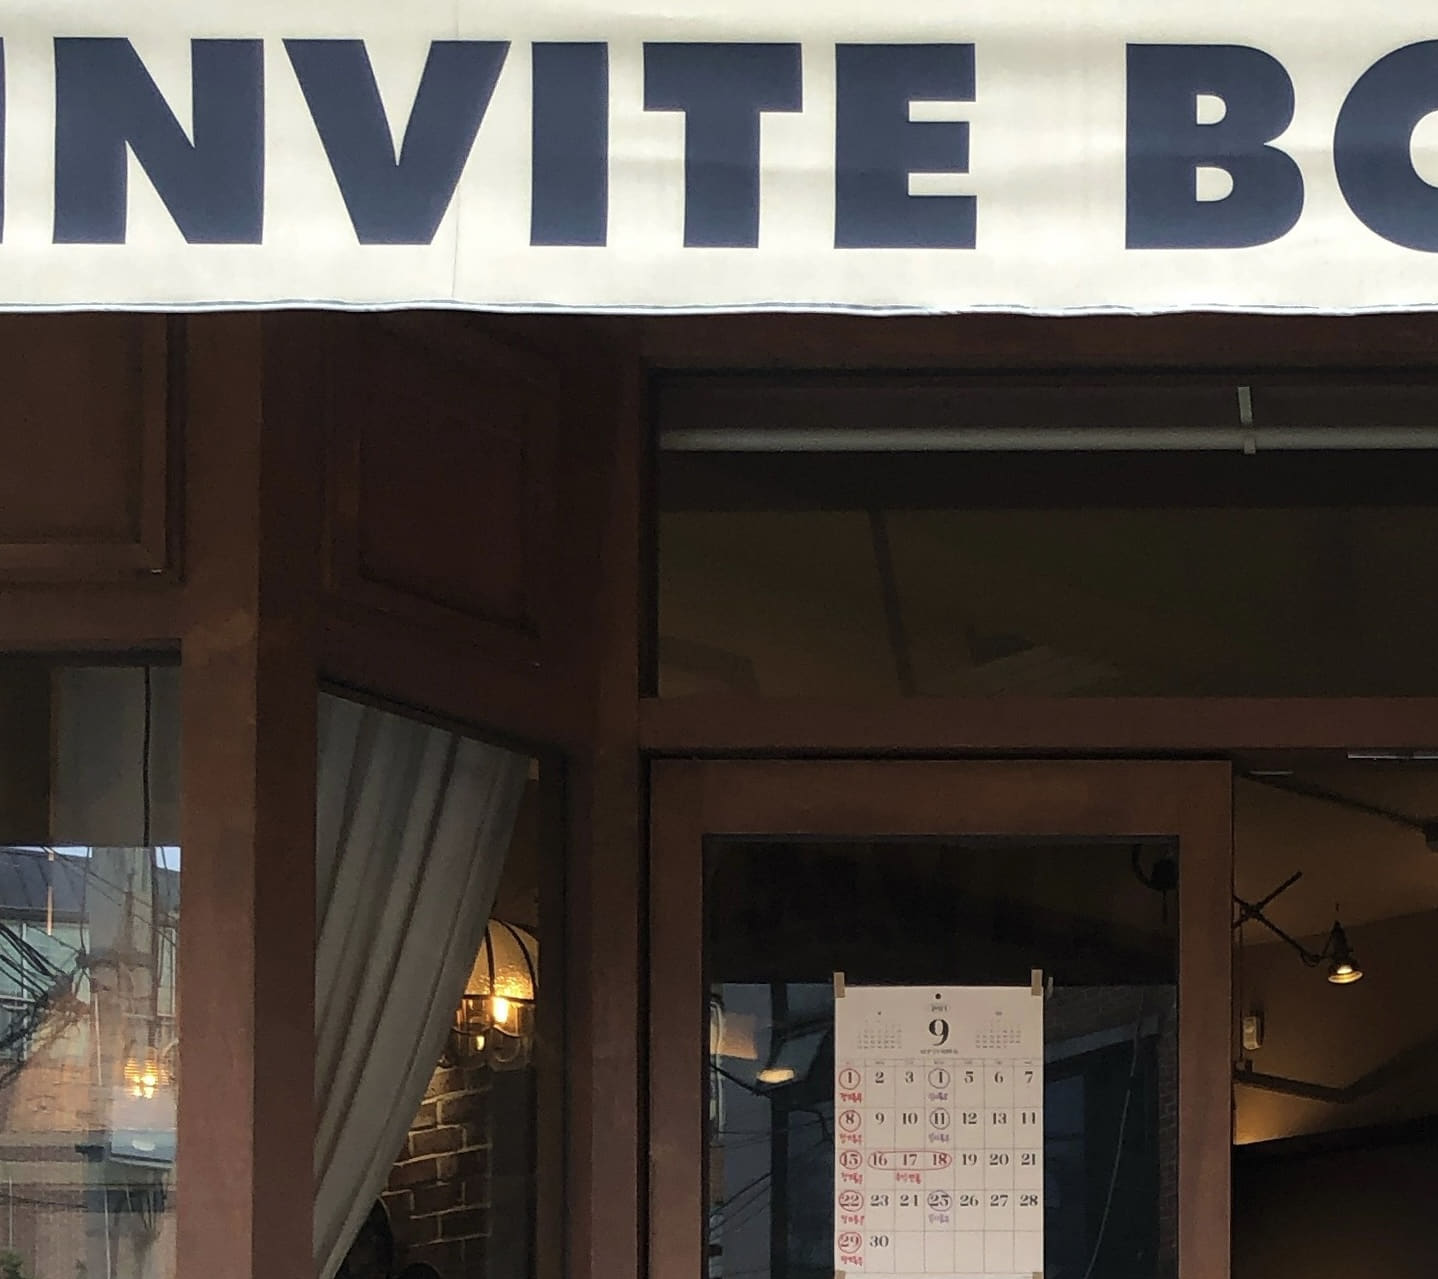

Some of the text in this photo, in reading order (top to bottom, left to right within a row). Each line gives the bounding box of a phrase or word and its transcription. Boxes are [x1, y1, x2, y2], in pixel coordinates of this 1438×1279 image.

[0, 36, 978, 250] NVITE
[928, 1018, 950, 1047] 9
[874, 1071, 885, 1084] 2
[904, 1071, 915, 1084] 3
[963, 1071, 975, 1084] 5
[993, 1071, 1004, 1084] 6
[1023, 1071, 1034, 1084] 7
[845, 1112, 855, 1125] 8
[874, 1112, 885, 1125] 9
[901, 1112, 919, 1125] 10
[933, 1112, 946, 1125] 11
[961, 1112, 978, 1125] 12
[991, 1112, 1008, 1125] 13
[840, 1153, 1037, 1166] 15 16 17 18 19 20 21
[839, 1194, 861, 1207] 22
[869, 1194, 890, 1207] 23
[928, 1194, 950, 1207] 25
[959, 1194, 980, 1207] 26
[989, 1194, 1009, 1207] 27
[1019, 1194, 1039, 1207] 28
[839, 1235, 890, 1248] 29 30
